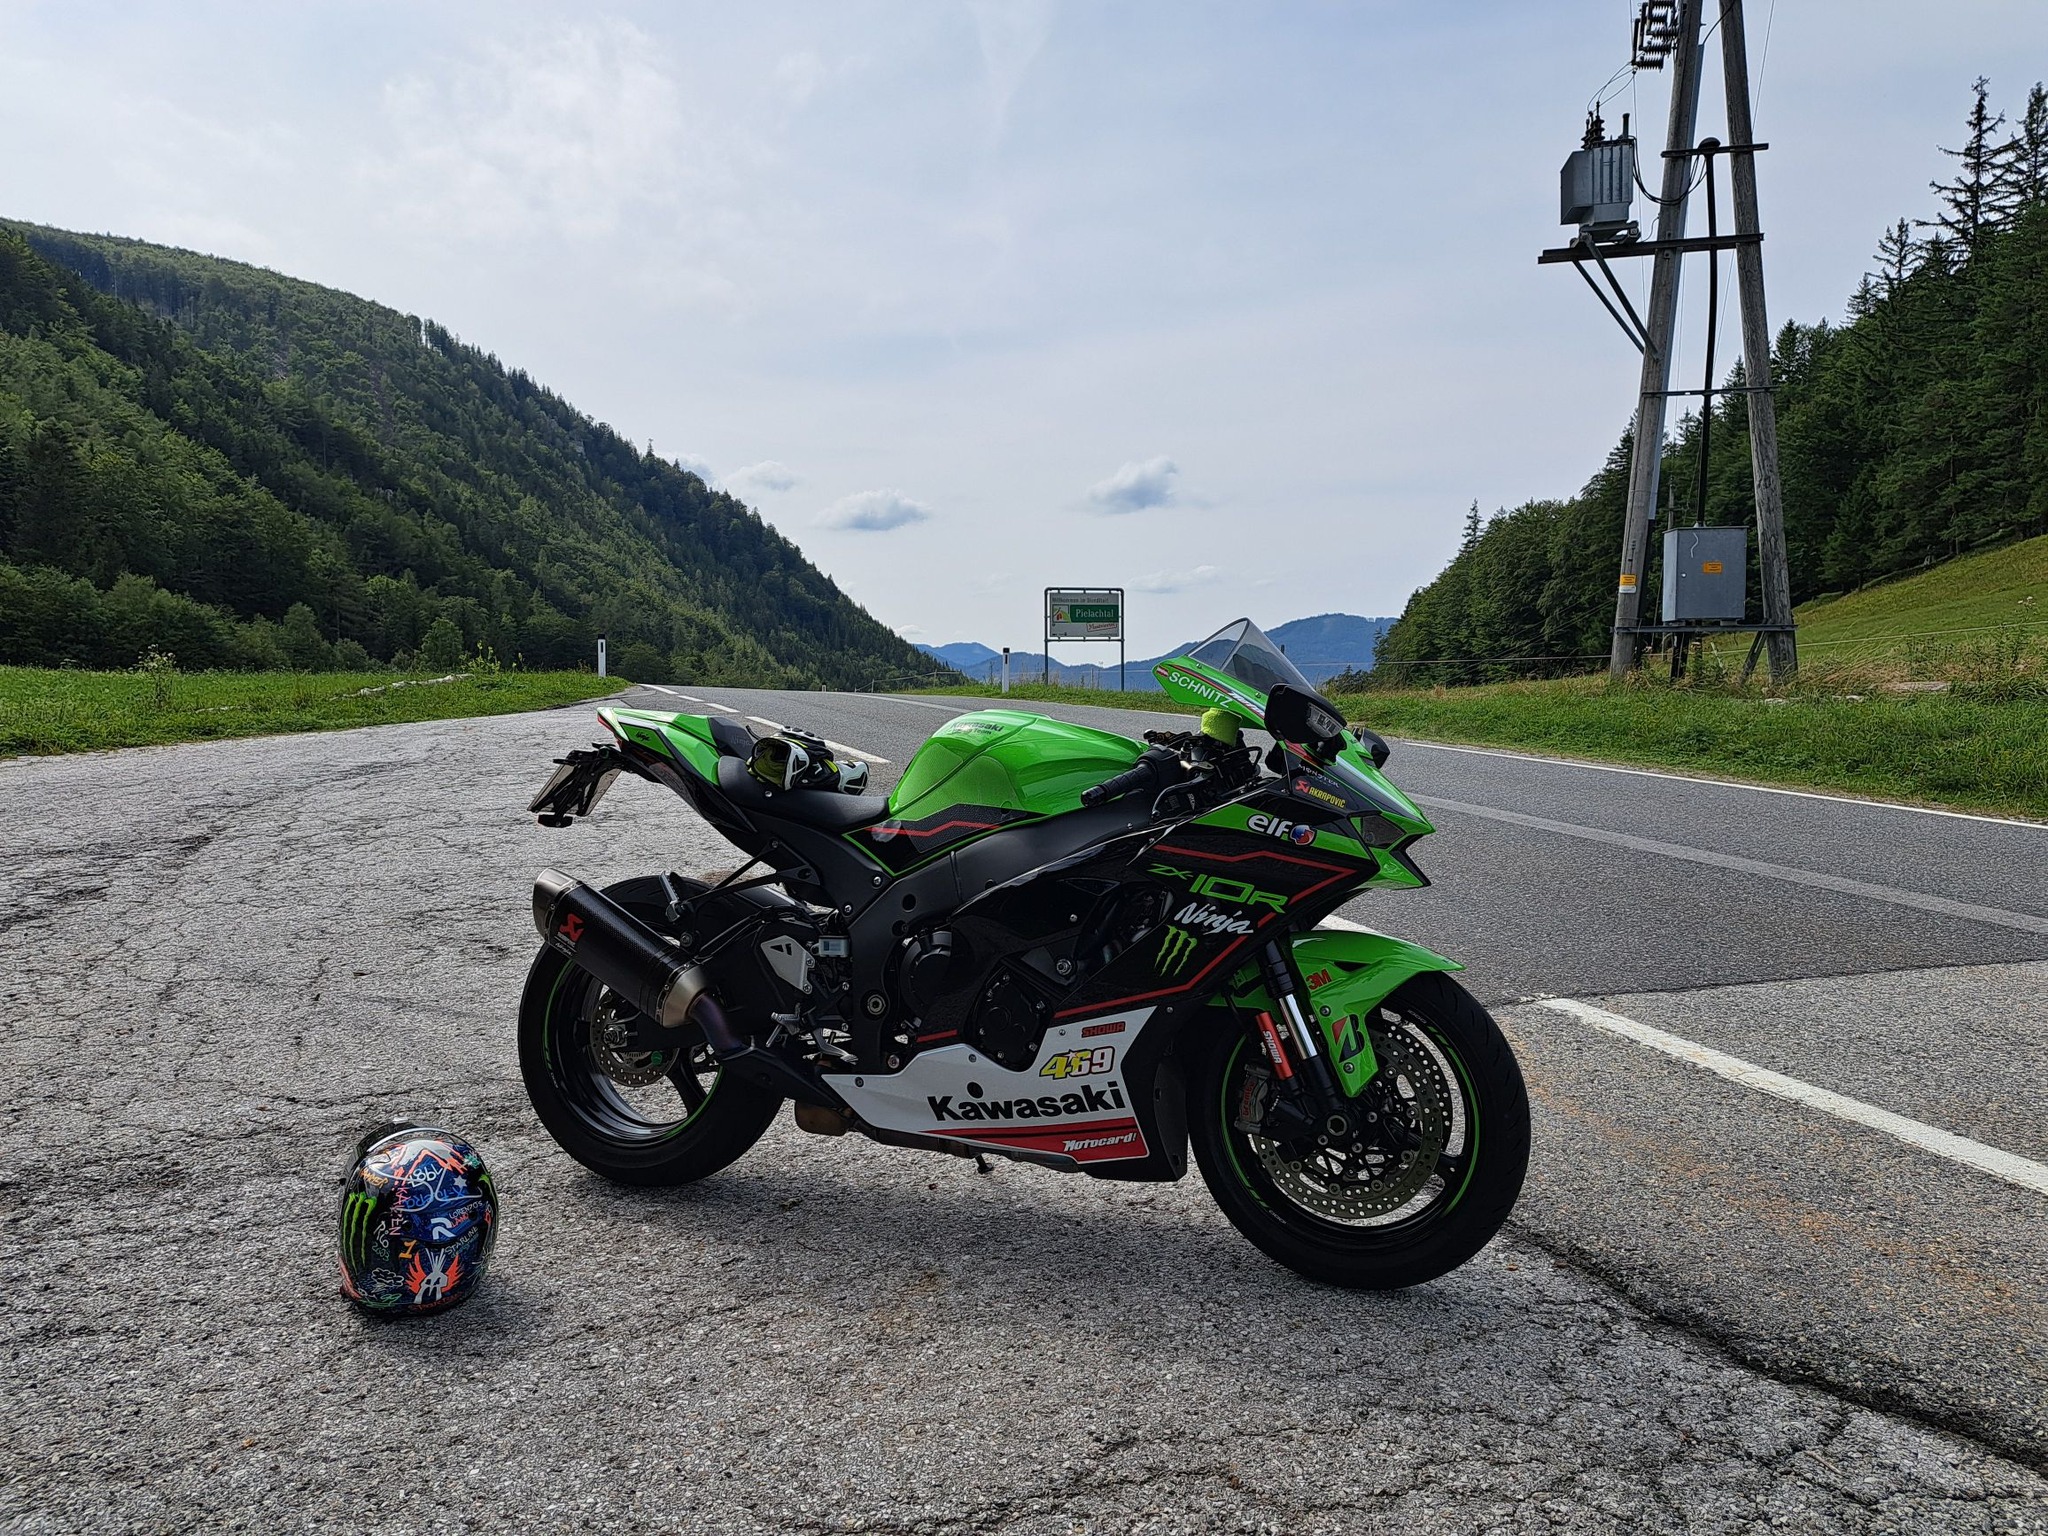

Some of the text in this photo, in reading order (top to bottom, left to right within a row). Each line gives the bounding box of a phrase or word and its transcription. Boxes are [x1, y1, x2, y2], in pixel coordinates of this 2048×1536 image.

[1075, 608, 1114, 618] Pielachtal
[1169, 671, 1235, 709] SCHNITZ
[1248, 814, 1293, 837] elf
[1174, 902, 1254, 935] Ninja
[1306, 968, 1333, 990] 3M
[1082, 1021, 1125, 1038] SHOWA
[1262, 1030, 1283, 1064] SHOWA
[927, 1081, 1126, 1121] Kawasaki
